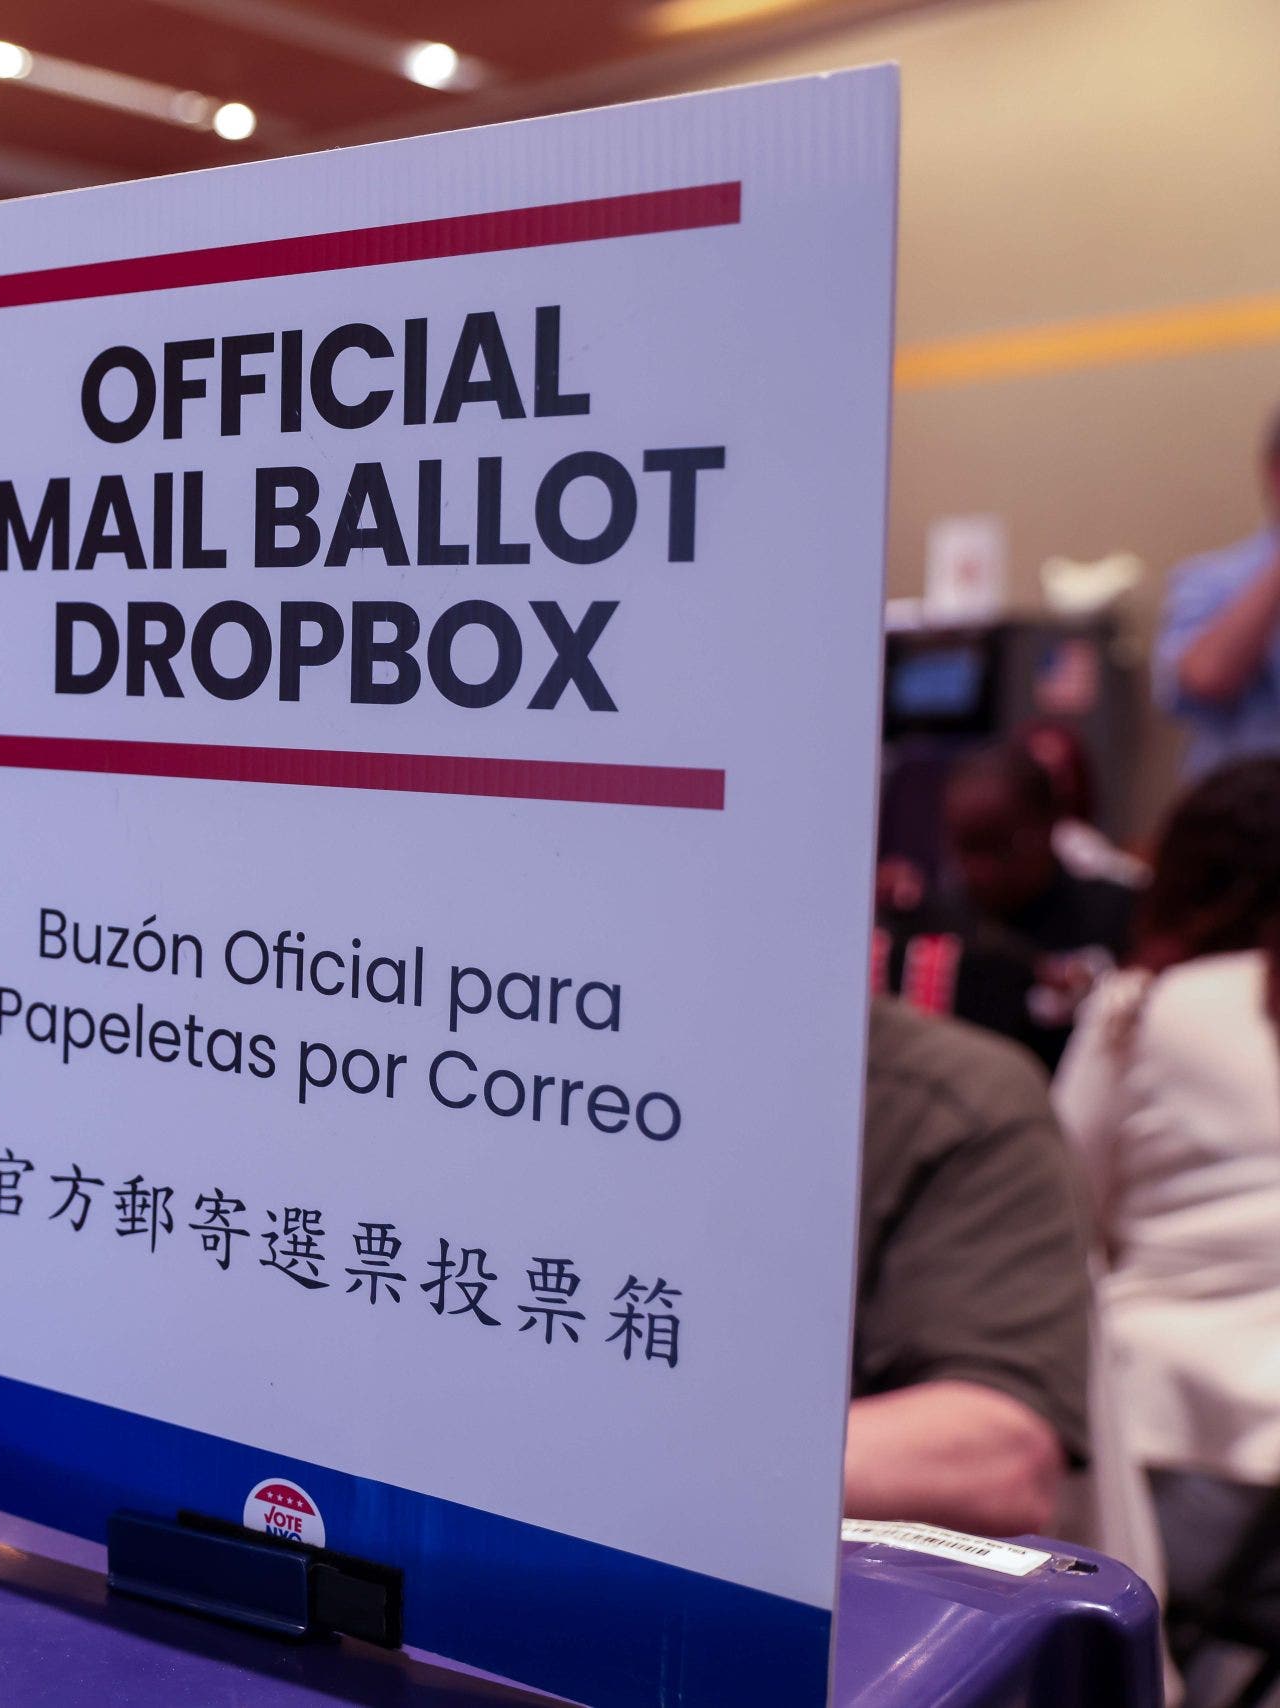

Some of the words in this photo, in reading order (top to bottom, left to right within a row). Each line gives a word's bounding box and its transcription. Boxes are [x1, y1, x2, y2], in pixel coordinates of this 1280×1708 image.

[81, 305, 590, 446] OFFICIAL
[255, 446, 726, 570] BALLOT
[55, 600, 620, 712] DROPBOX
[39, 908, 203, 979] Buzón
[225, 929, 424, 1007] Oficial
[450, 966, 621, 1033] para
[298, 1040, 408, 1105] por
[428, 1049, 682, 1142] Correo
